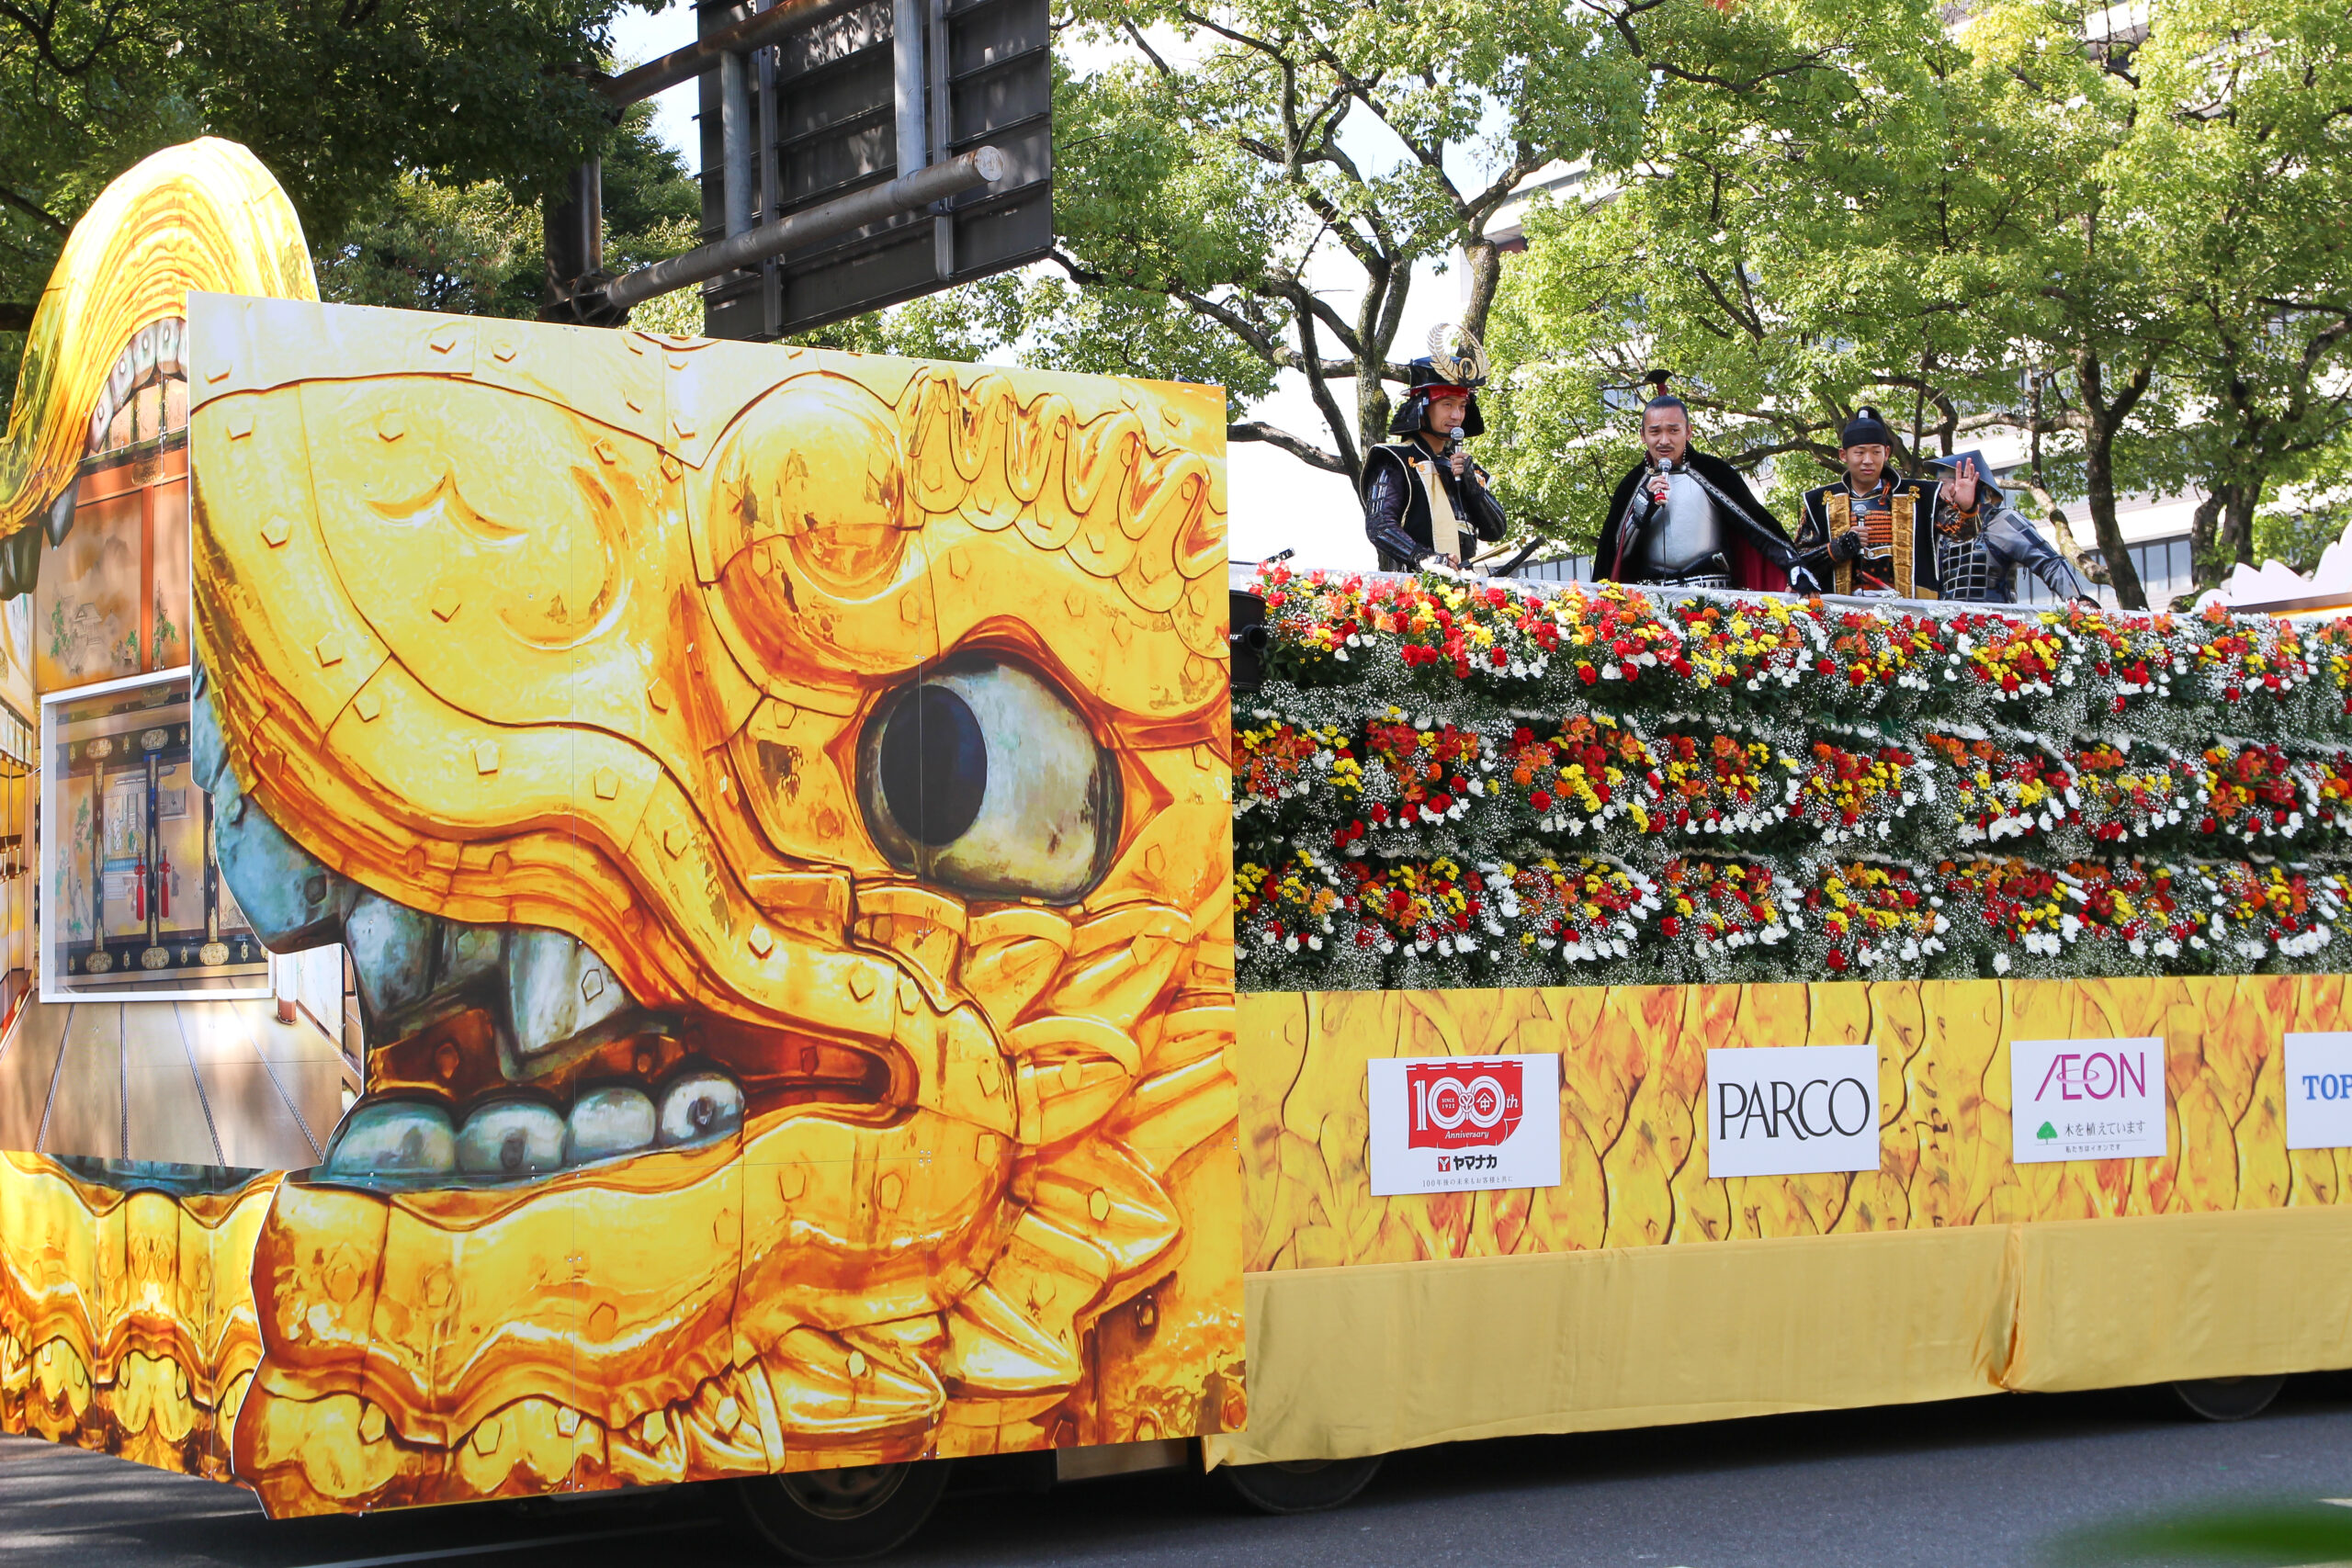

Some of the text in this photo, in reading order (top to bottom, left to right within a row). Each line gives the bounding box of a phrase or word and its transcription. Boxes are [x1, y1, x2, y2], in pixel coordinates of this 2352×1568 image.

[1717, 1077, 1871, 1141] PARCO
[1444, 1130, 1489, 1139] Anniversary
[2064, 1120, 2146, 1137] 木を植えています
[1453, 1154, 1498, 1171] ヤマナカ
